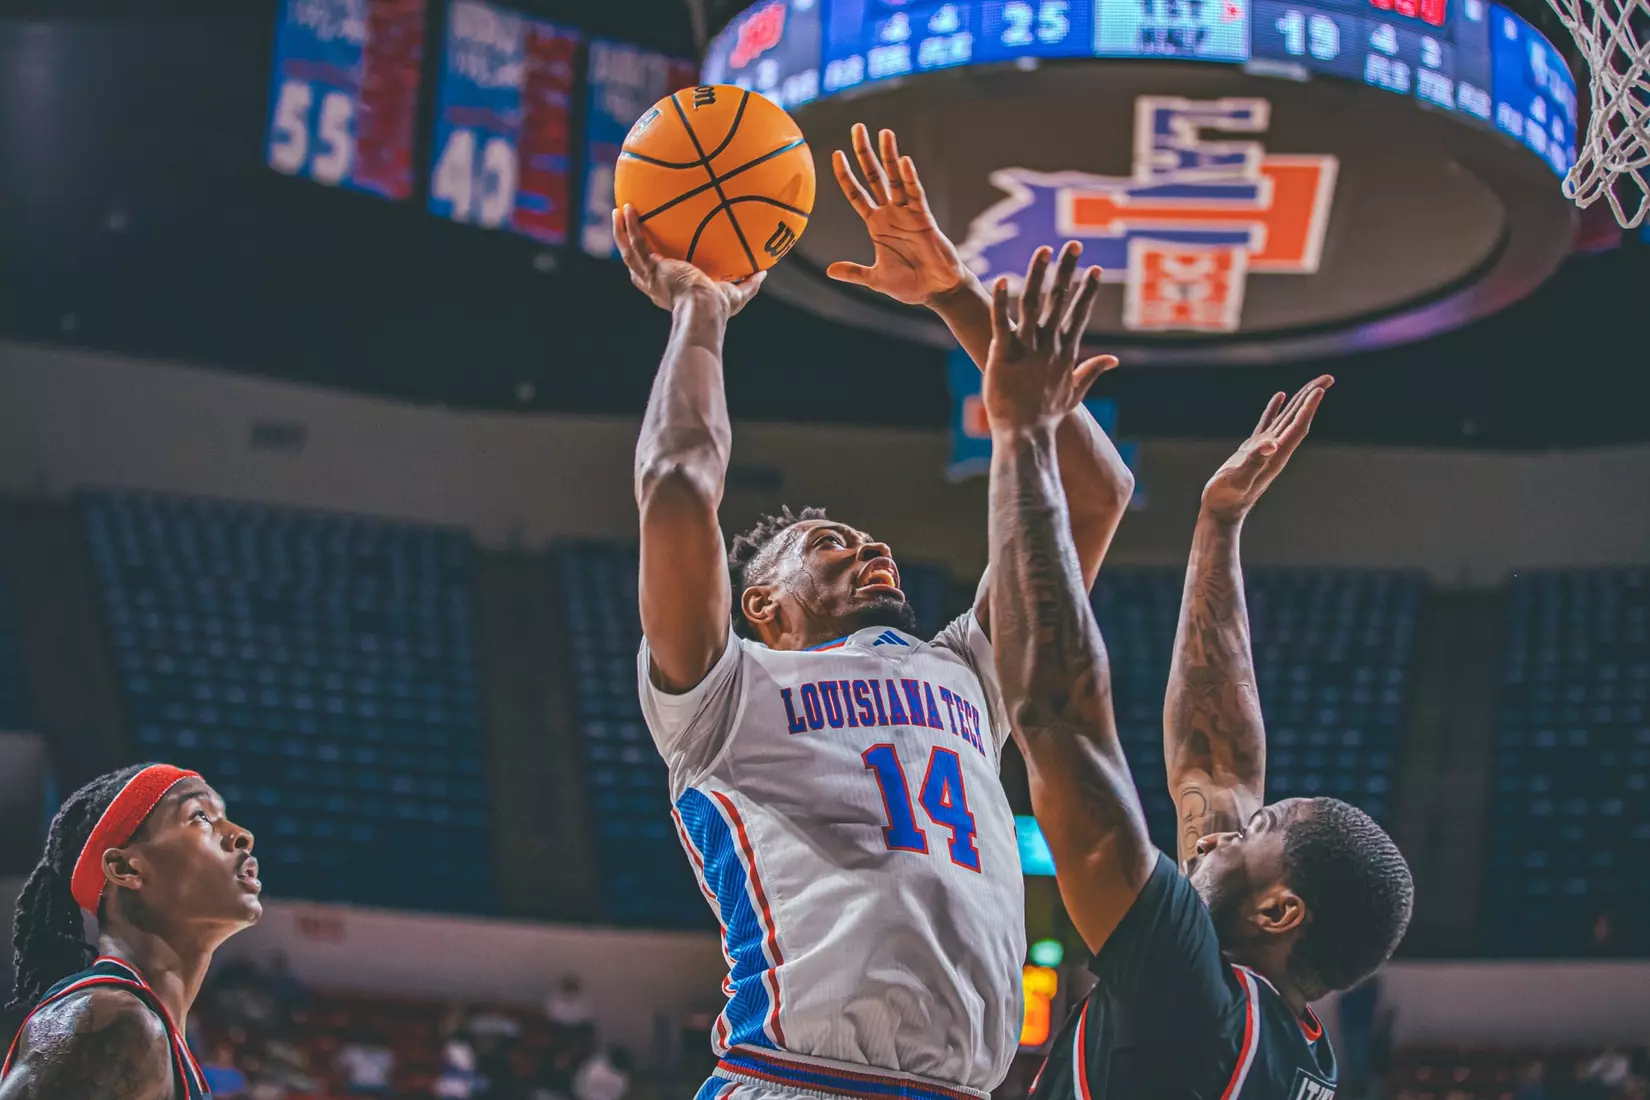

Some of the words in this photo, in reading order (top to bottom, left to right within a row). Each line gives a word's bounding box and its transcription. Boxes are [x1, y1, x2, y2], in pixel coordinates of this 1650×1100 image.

[780, 678, 944, 734] LOUISIANA
[938, 685, 986, 758] TECH
[861, 743, 981, 874] 14
